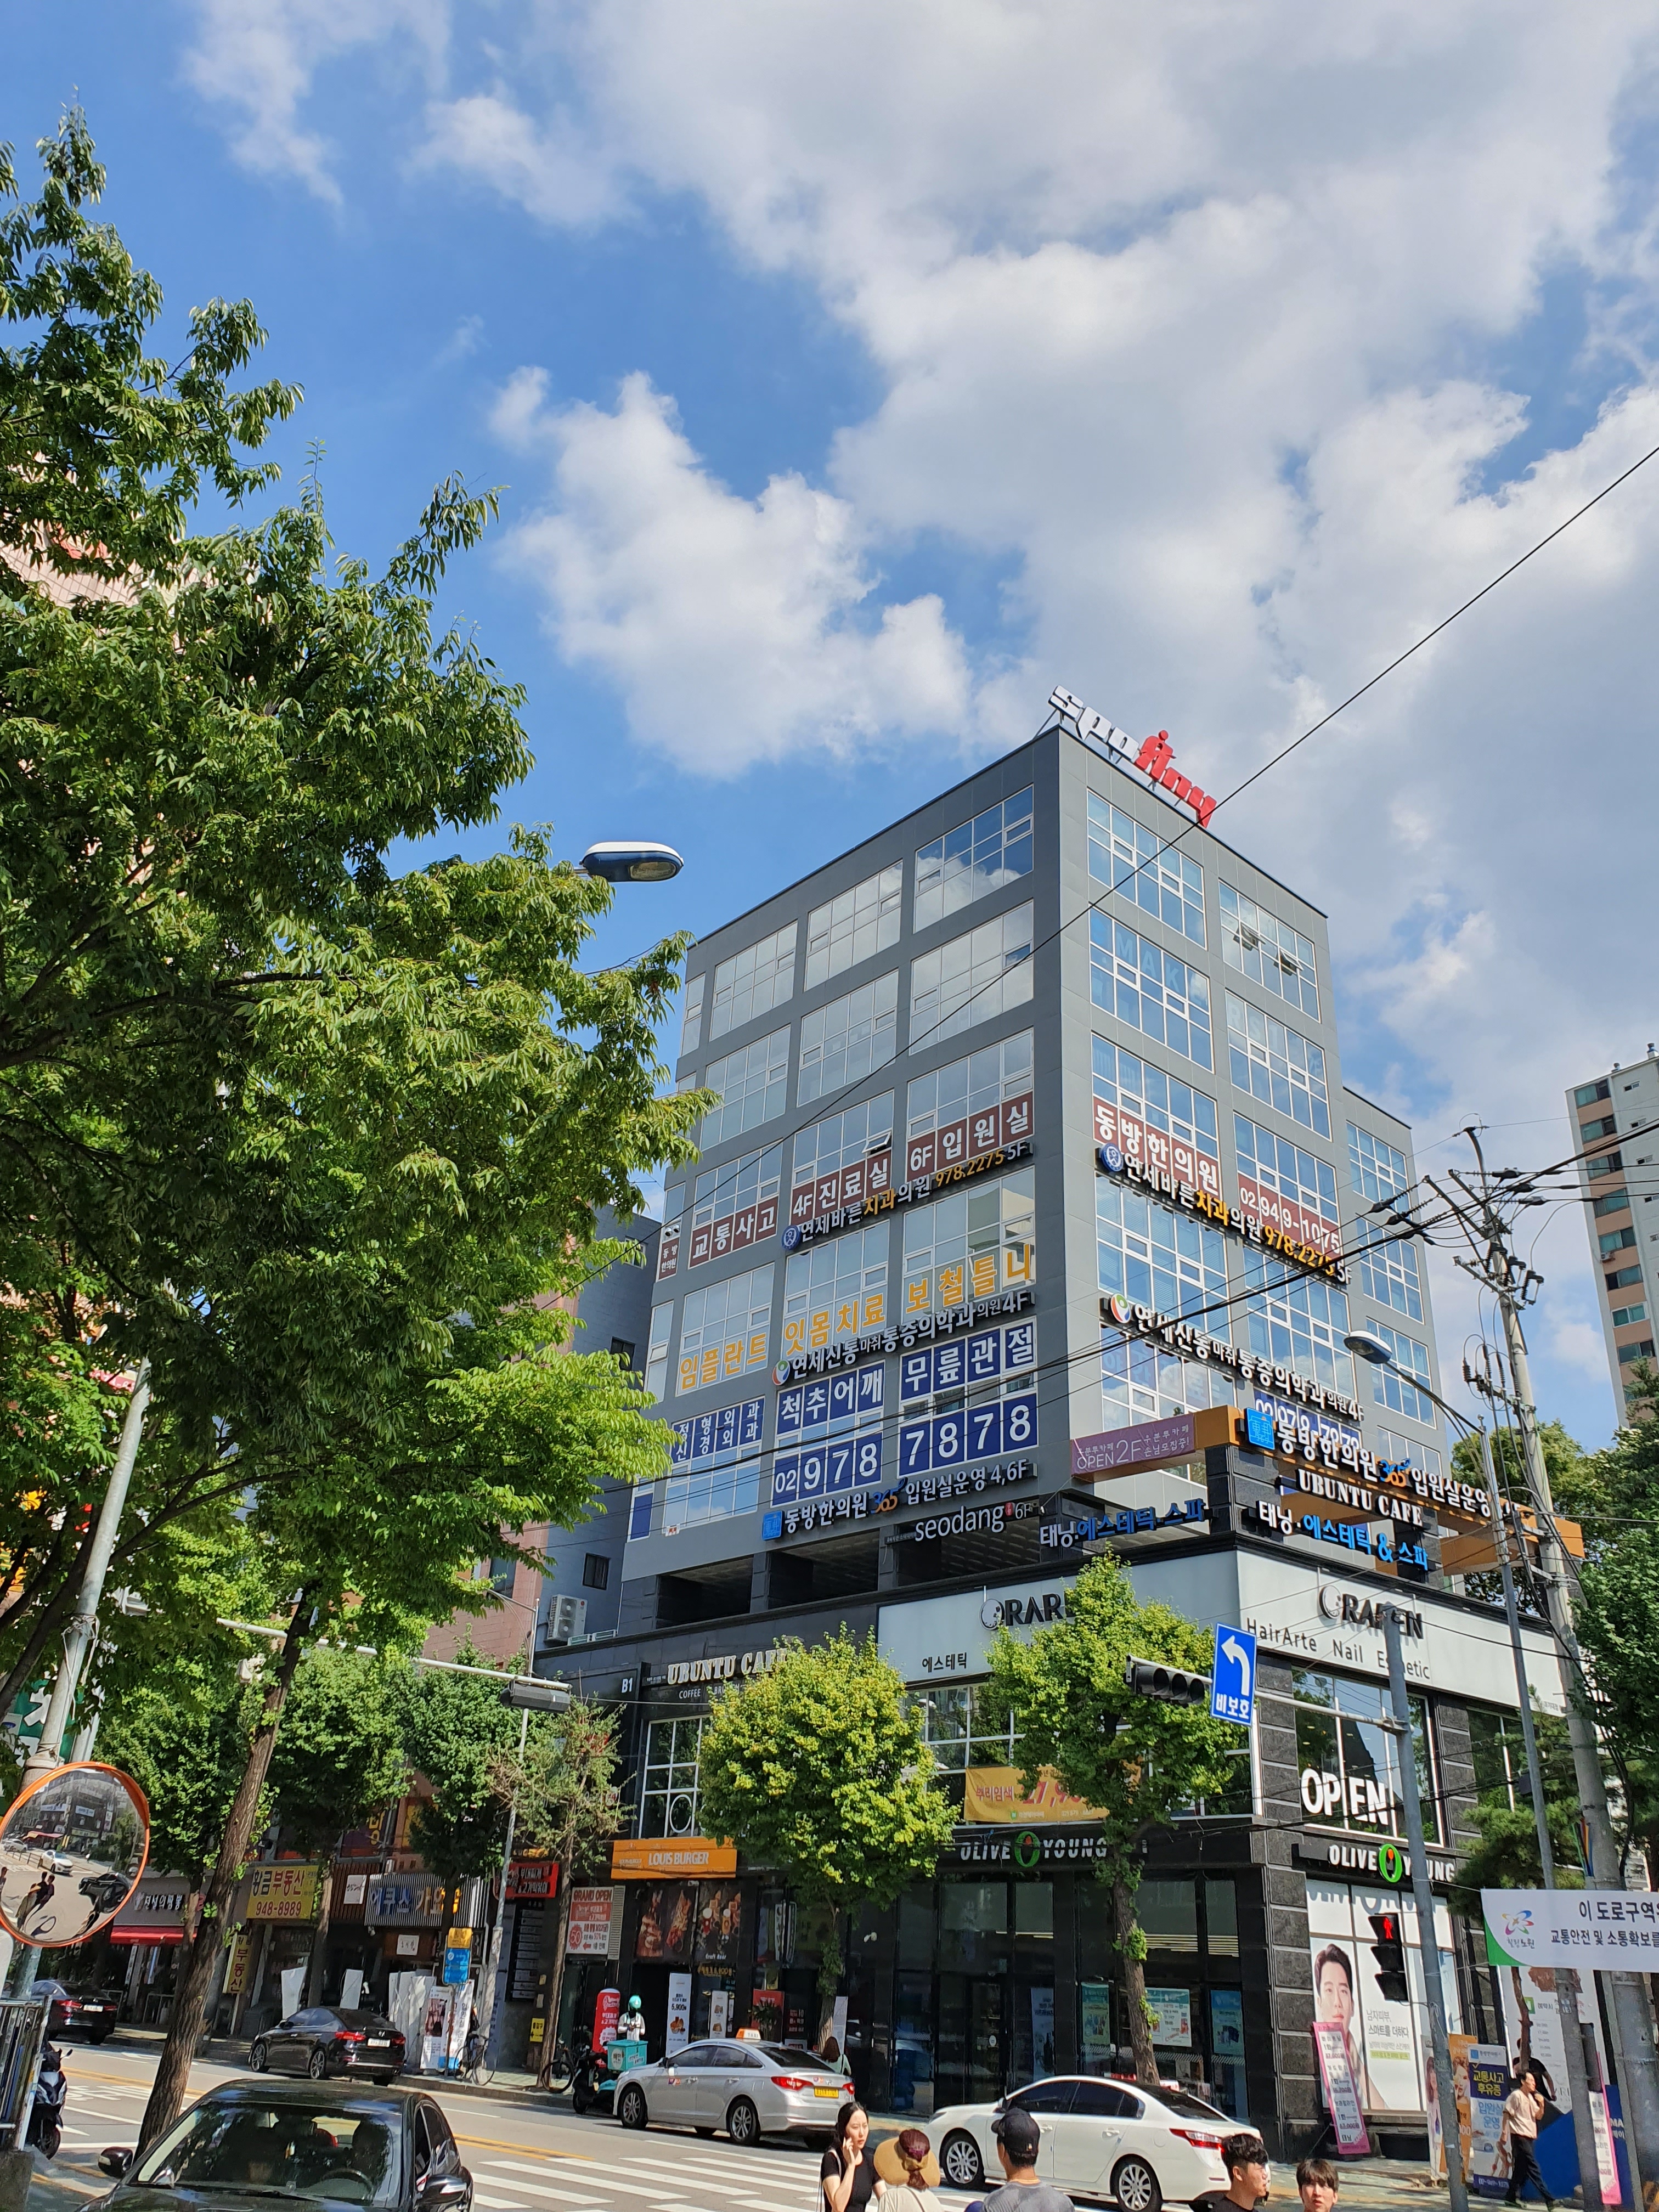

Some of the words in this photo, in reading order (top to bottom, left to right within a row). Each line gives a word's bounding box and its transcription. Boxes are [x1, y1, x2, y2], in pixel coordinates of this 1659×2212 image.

[1095, 1104, 1218, 1196] 동방한의원
[935, 1148, 1005, 1188] 978.2275
[1007, 1142, 1027, 1162] 5F
[692, 1205, 776, 1259] 교통사고
[793, 1193, 814, 1218] 4F
[818, 1157, 890, 1209] 진료실
[910, 1144, 934, 1171] 6F
[942, 1102, 1029, 1160] 입원실
[661, 1258, 676, 1273] 한의원
[1265, 1225, 1334, 1277] 978.2275
[1003, 1290, 1028, 1312] 4F
[679, 1332, 768, 1390] 임플란트
[785, 1293, 885, 1357] 잇몸치료
[906, 1244, 1031, 1312] 보철틀니
[781, 1363, 883, 1425] 척추어깨
[905, 1325, 1034, 1392] 무릎관절
[1348, 1399, 1364, 1422] 4F
[675, 1423, 759, 1462] 신경외과
[909, 1404, 1031, 1466] 7878
[1144, 1436, 1190, 1458] 손님모집중!
[1077, 1452, 1114, 1470] OPEN
[1116, 1440, 1142, 1464] 2F
[1277, 1420, 1378, 1483] 동방한의원
[1410, 1466, 1492, 1518] 입원실운영
[785, 1491, 867, 1534] 동방한의원
[905, 1468, 986, 1505] 입원실운영
[990, 1459, 1028, 1486] 4,6F
[1298, 1468, 1373, 1511] UBUNTU
[1378, 1494, 1423, 1527] CAFE
[914, 1505, 1005, 1542] seodang
[1398, 1541, 1429, 1571] 스파
[1246, 1617, 1318, 1654] HairArte
[1332, 1638, 1363, 1664] Nail
[667, 1655, 737, 1685] UBUNTU
[922, 1651, 968, 1672] 에스테틱
[621, 1677, 633, 1694] B1
[679, 1688, 701, 1700] COFFEE
[1215, 1691, 1250, 1720] 비보호
[1300, 1767, 1389, 1826] OPEN
[648, 1852, 673, 1866] LOUIS
[674, 1851, 710, 1865] BURGER
[960, 1839, 1011, 1861] OLIVE
[1042, 1837, 1108, 1859] YOUNG
[1329, 1844, 1377, 1872] OLIVE
[1402, 1855, 1455, 1882] YUNG
[252, 1869, 305, 1897] 황금부동산
[573, 1889, 595, 1902] GRAND
[595, 1889, 613, 1901] OPEN
[255, 1900, 302, 1917] 948-8989
[1579, 1900, 1593, 1922] 이
[1596, 1901, 1659, 1923] 도로구역
[1550, 1929, 1591, 1945] 교통안전
[1593, 1929, 1604, 1946] 및
[230, 1948, 249, 1993] 부동산
[1368, 2024, 1391, 2037] 스마트를
[1391, 2025, 1409, 2039] 더하다
[1472, 2070, 1505, 2084] 교통사고
[1477, 2083, 1502, 2097] 후유증
[1483, 2116, 1501, 2130] 운영
